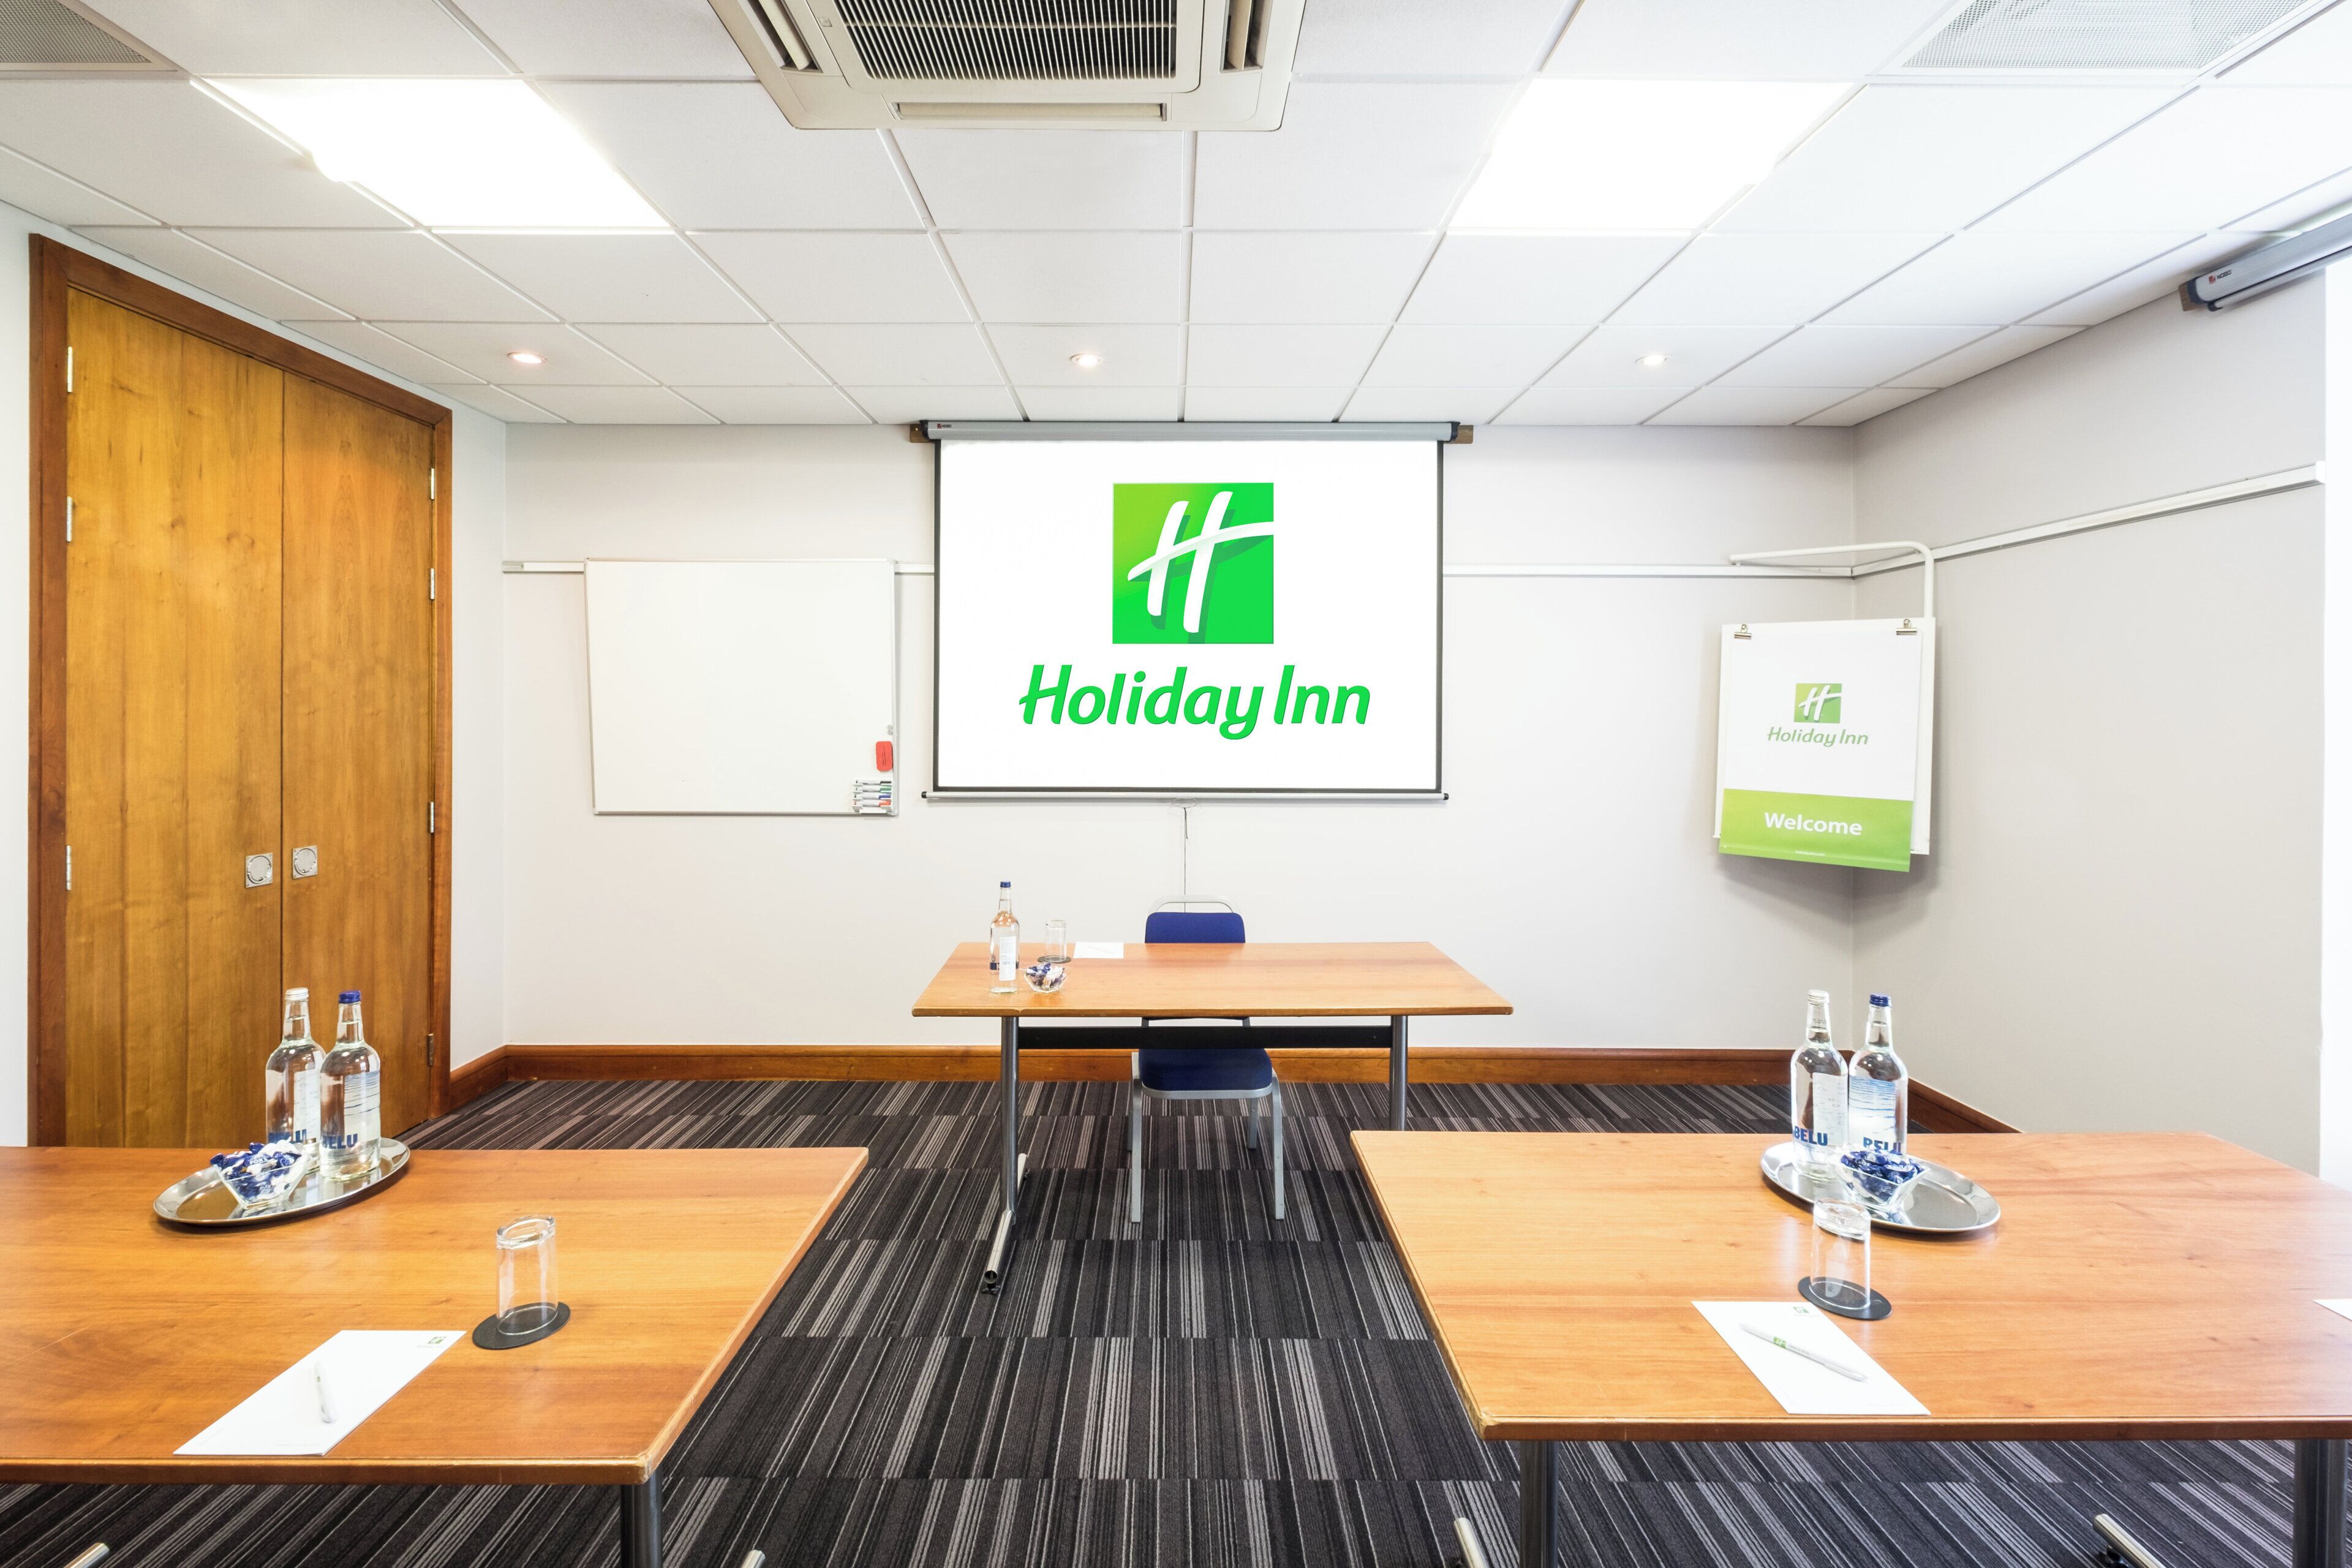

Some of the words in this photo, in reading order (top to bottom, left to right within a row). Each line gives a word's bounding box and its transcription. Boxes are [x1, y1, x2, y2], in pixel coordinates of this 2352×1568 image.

[1019, 665, 1264, 740] Holiday
[1273, 665, 1371, 725] Inn
[1766, 726, 1836, 747] Holiday
[1839, 729, 1869, 745] Inn
[1765, 812, 1863, 835] Welcome
[1794, 1126, 1828, 1146] BELU
